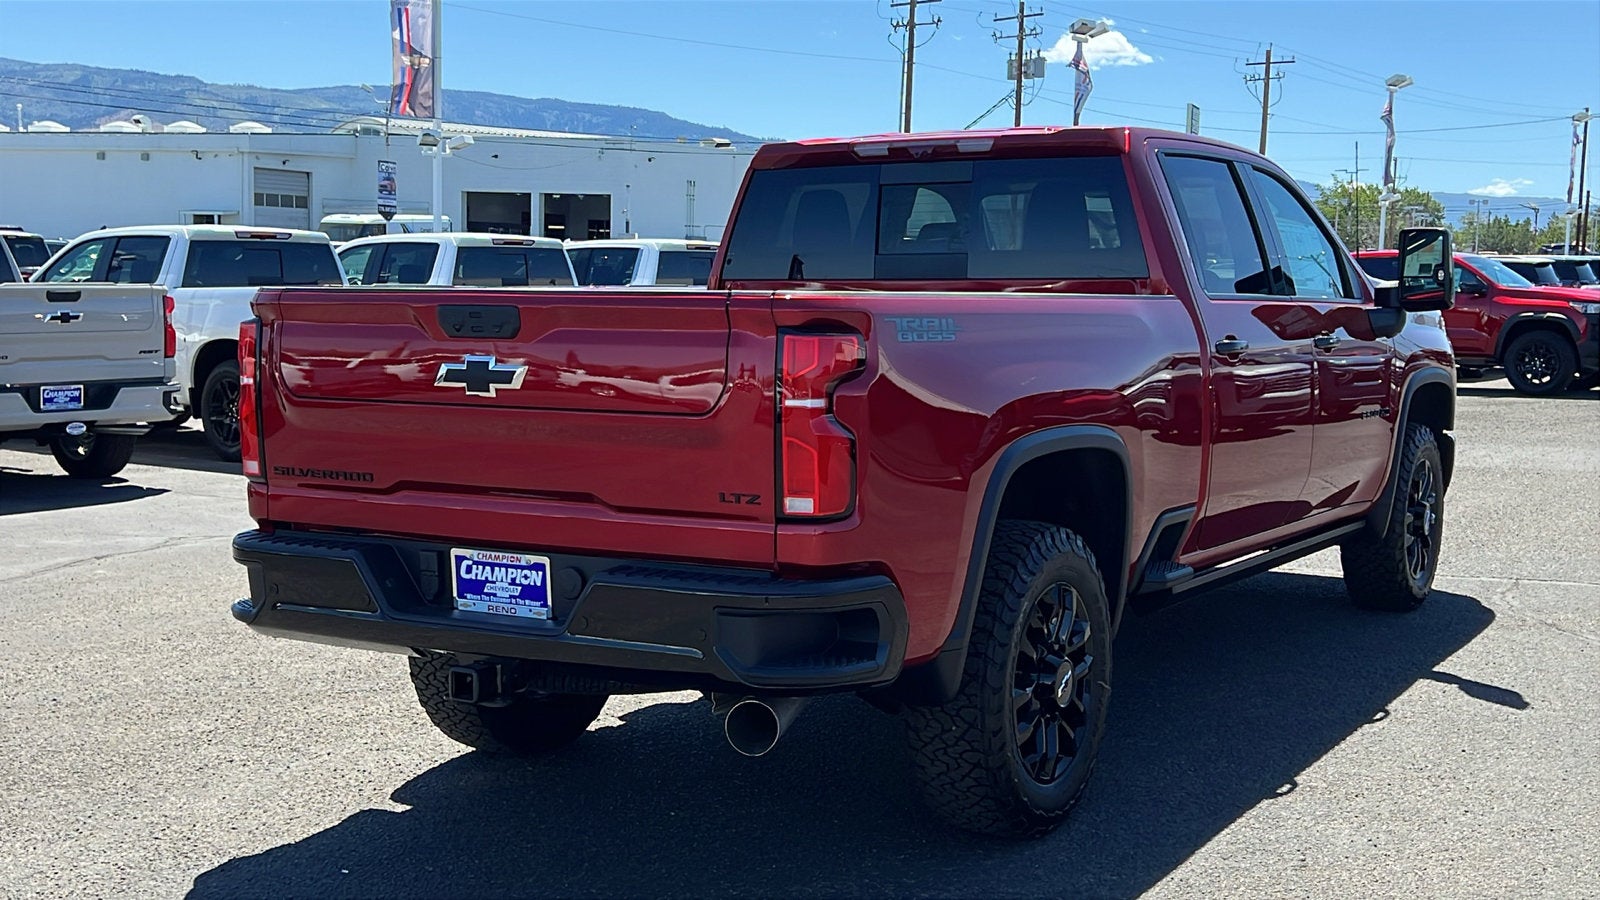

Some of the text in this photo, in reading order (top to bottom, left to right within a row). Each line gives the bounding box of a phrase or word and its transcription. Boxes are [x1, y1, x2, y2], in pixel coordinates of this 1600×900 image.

[884, 316, 964, 331] TRAIL
[898, 331, 956, 342] BOSS
[43, 389, 80, 398] CHAMPION
[273, 465, 374, 483] SILVERADO
[718, 492, 762, 506] LTZ
[476, 552, 522, 564] CHAMPION
[460, 559, 543, 586] CHAMPION
[486, 584, 519, 594] CHEVROLET
[487, 604, 518, 615] RENO
